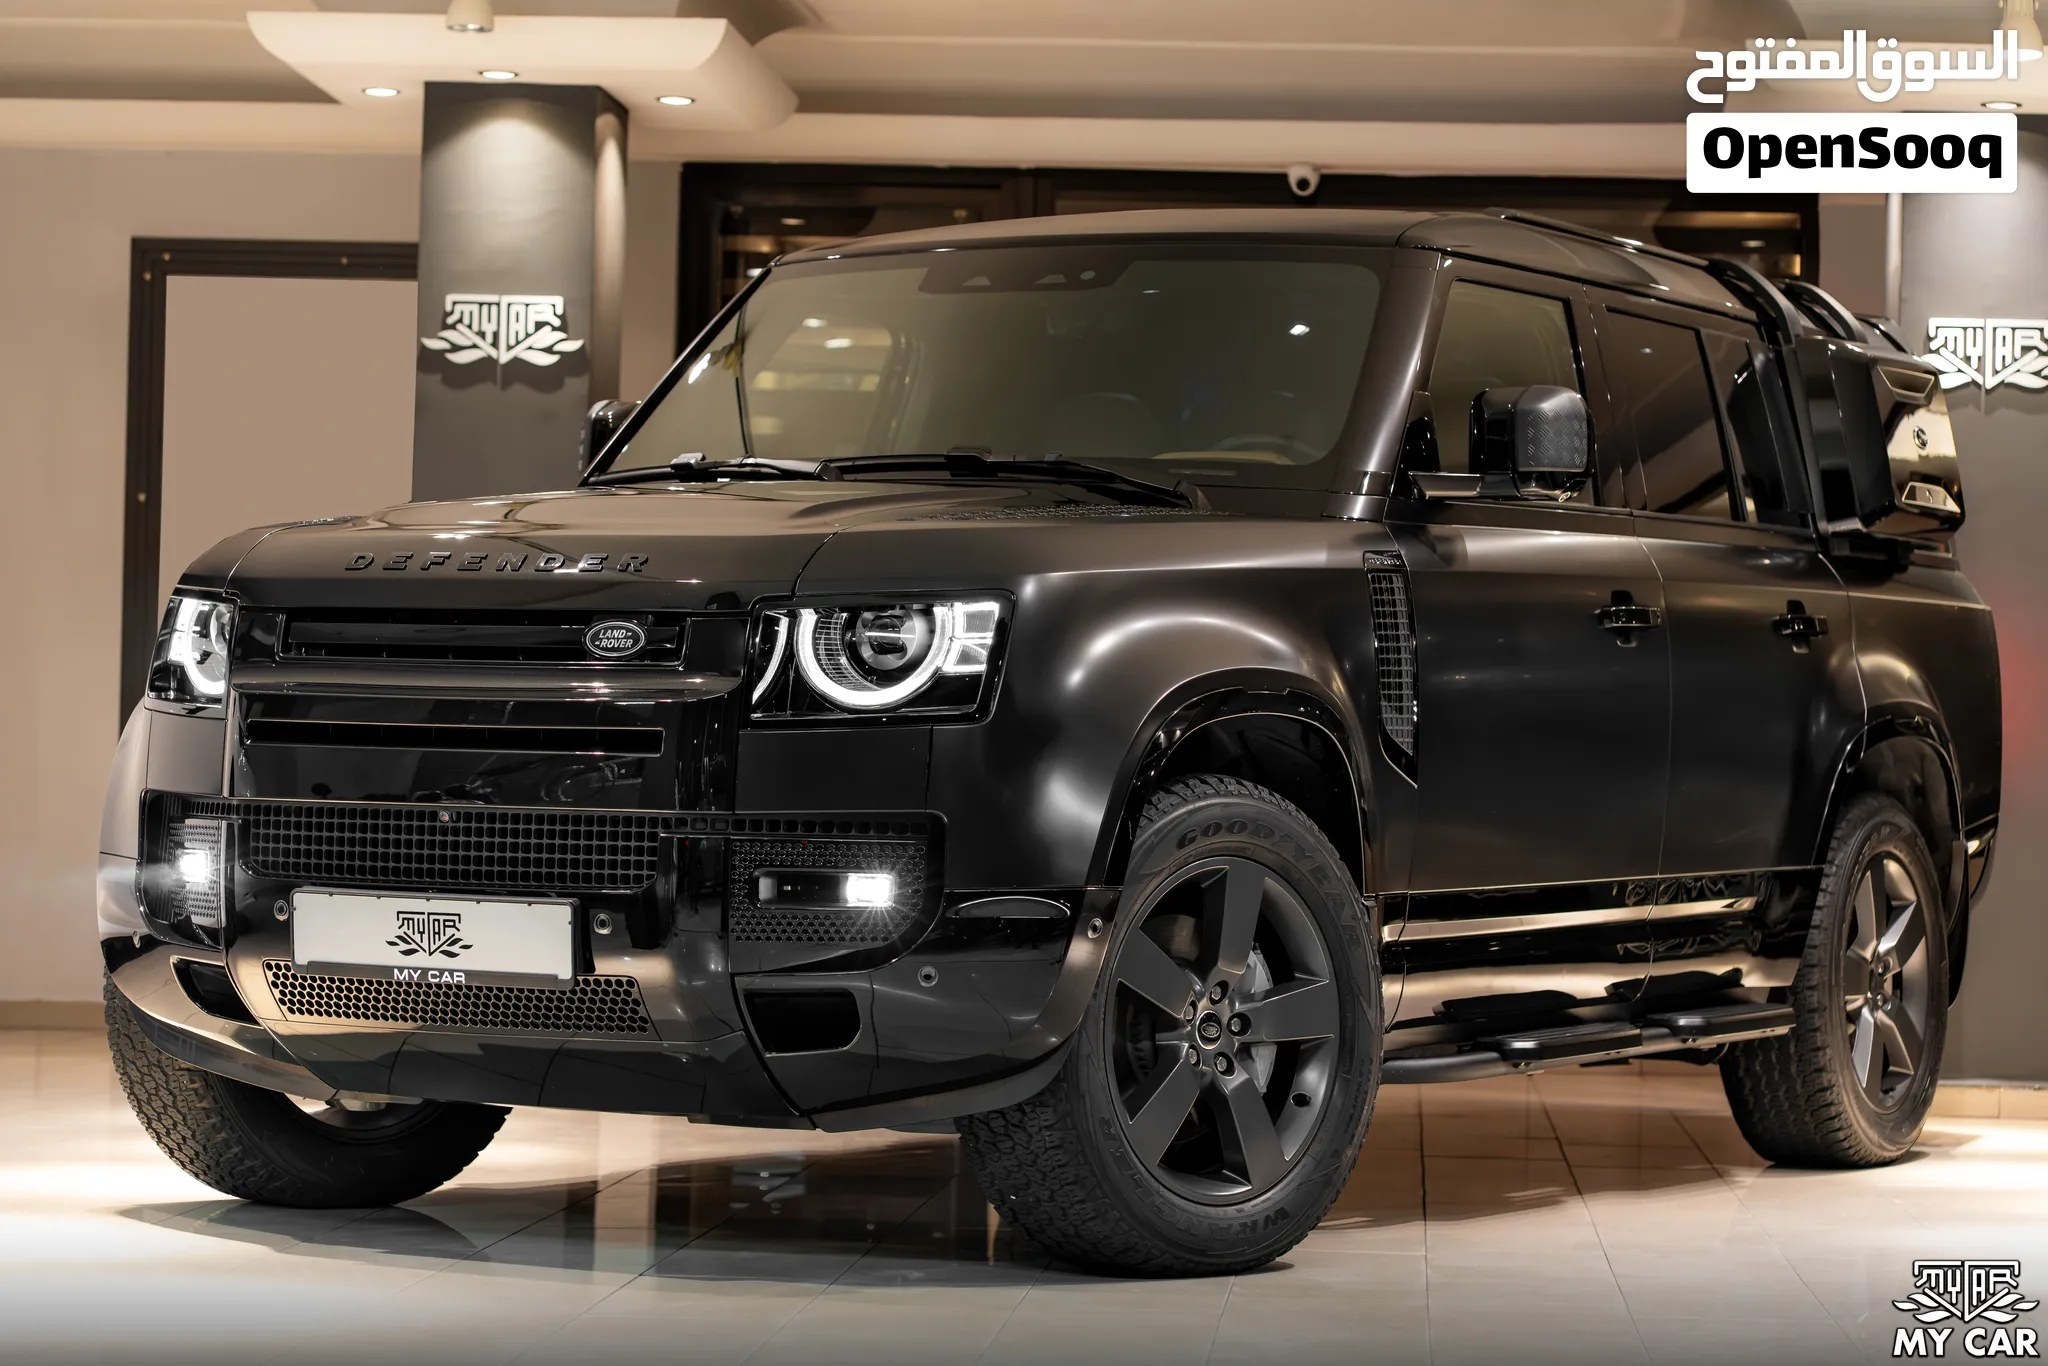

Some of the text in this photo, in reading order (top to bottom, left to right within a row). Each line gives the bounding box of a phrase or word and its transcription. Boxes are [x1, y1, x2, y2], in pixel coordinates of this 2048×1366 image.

[344, 551, 650, 573] DEFENDER
[598, 629, 626, 638] LAND
[599, 638, 633, 648] ROVER
[393, 968, 466, 984] MY CAR
